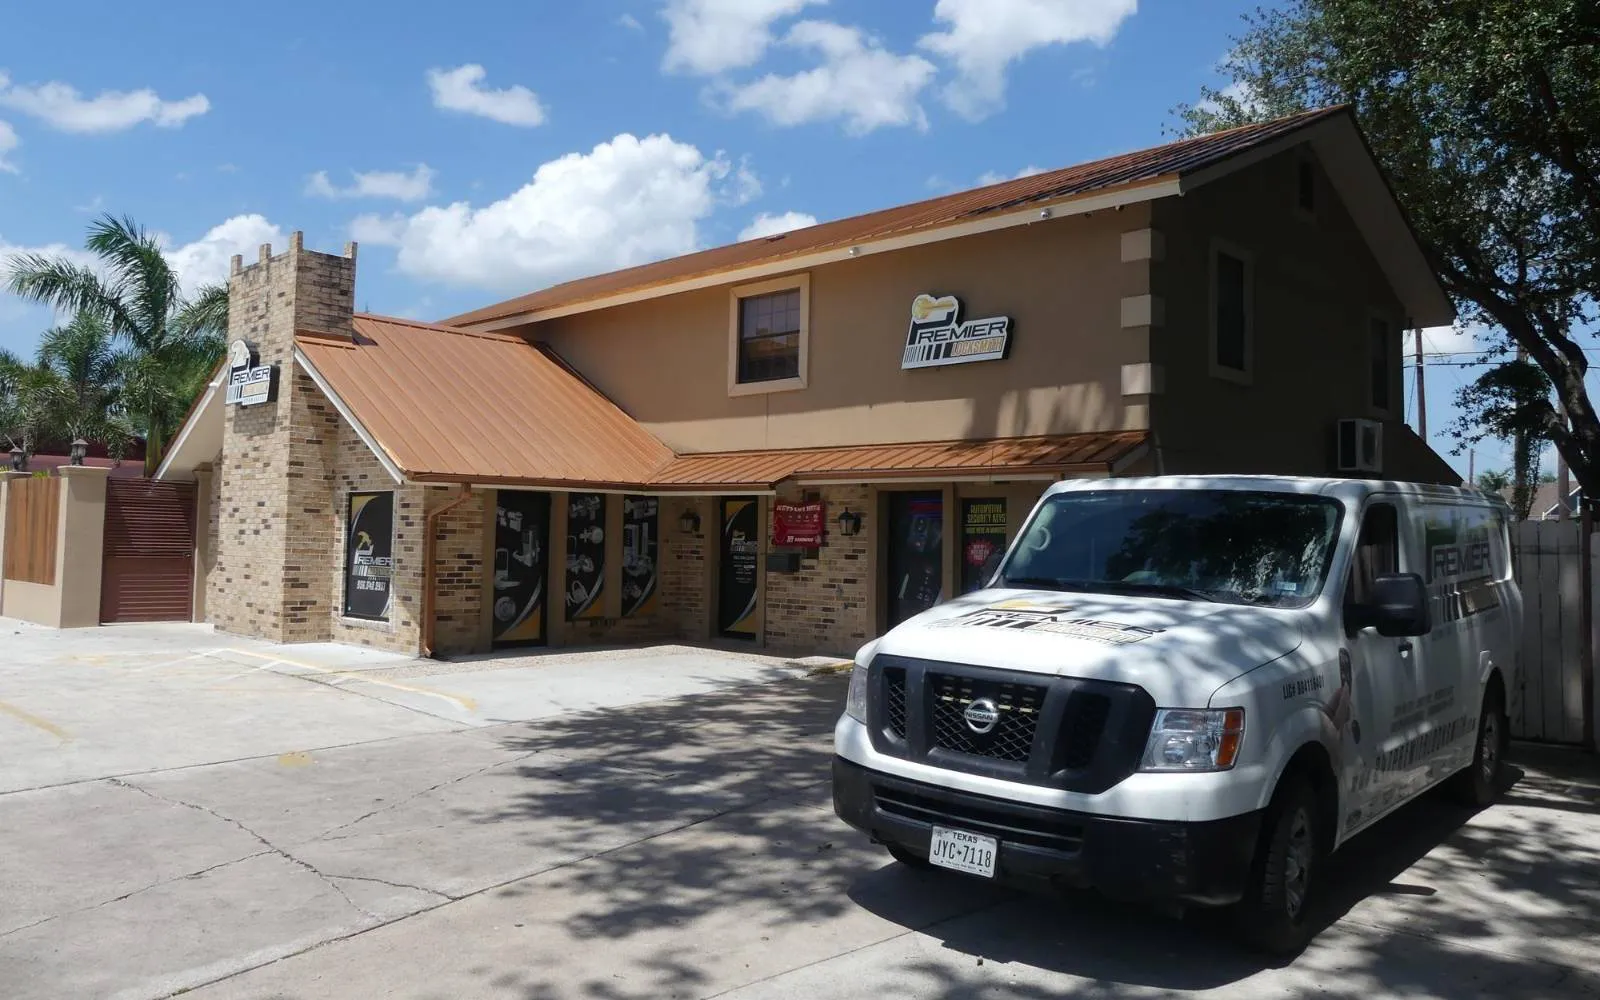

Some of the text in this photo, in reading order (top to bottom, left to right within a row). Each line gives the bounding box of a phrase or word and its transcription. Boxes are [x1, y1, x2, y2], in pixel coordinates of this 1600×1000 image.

[907, 309, 1006, 346] PREMIER
[964, 710, 993, 721] NISSAN
[953, 831, 978, 844] TEXAS
